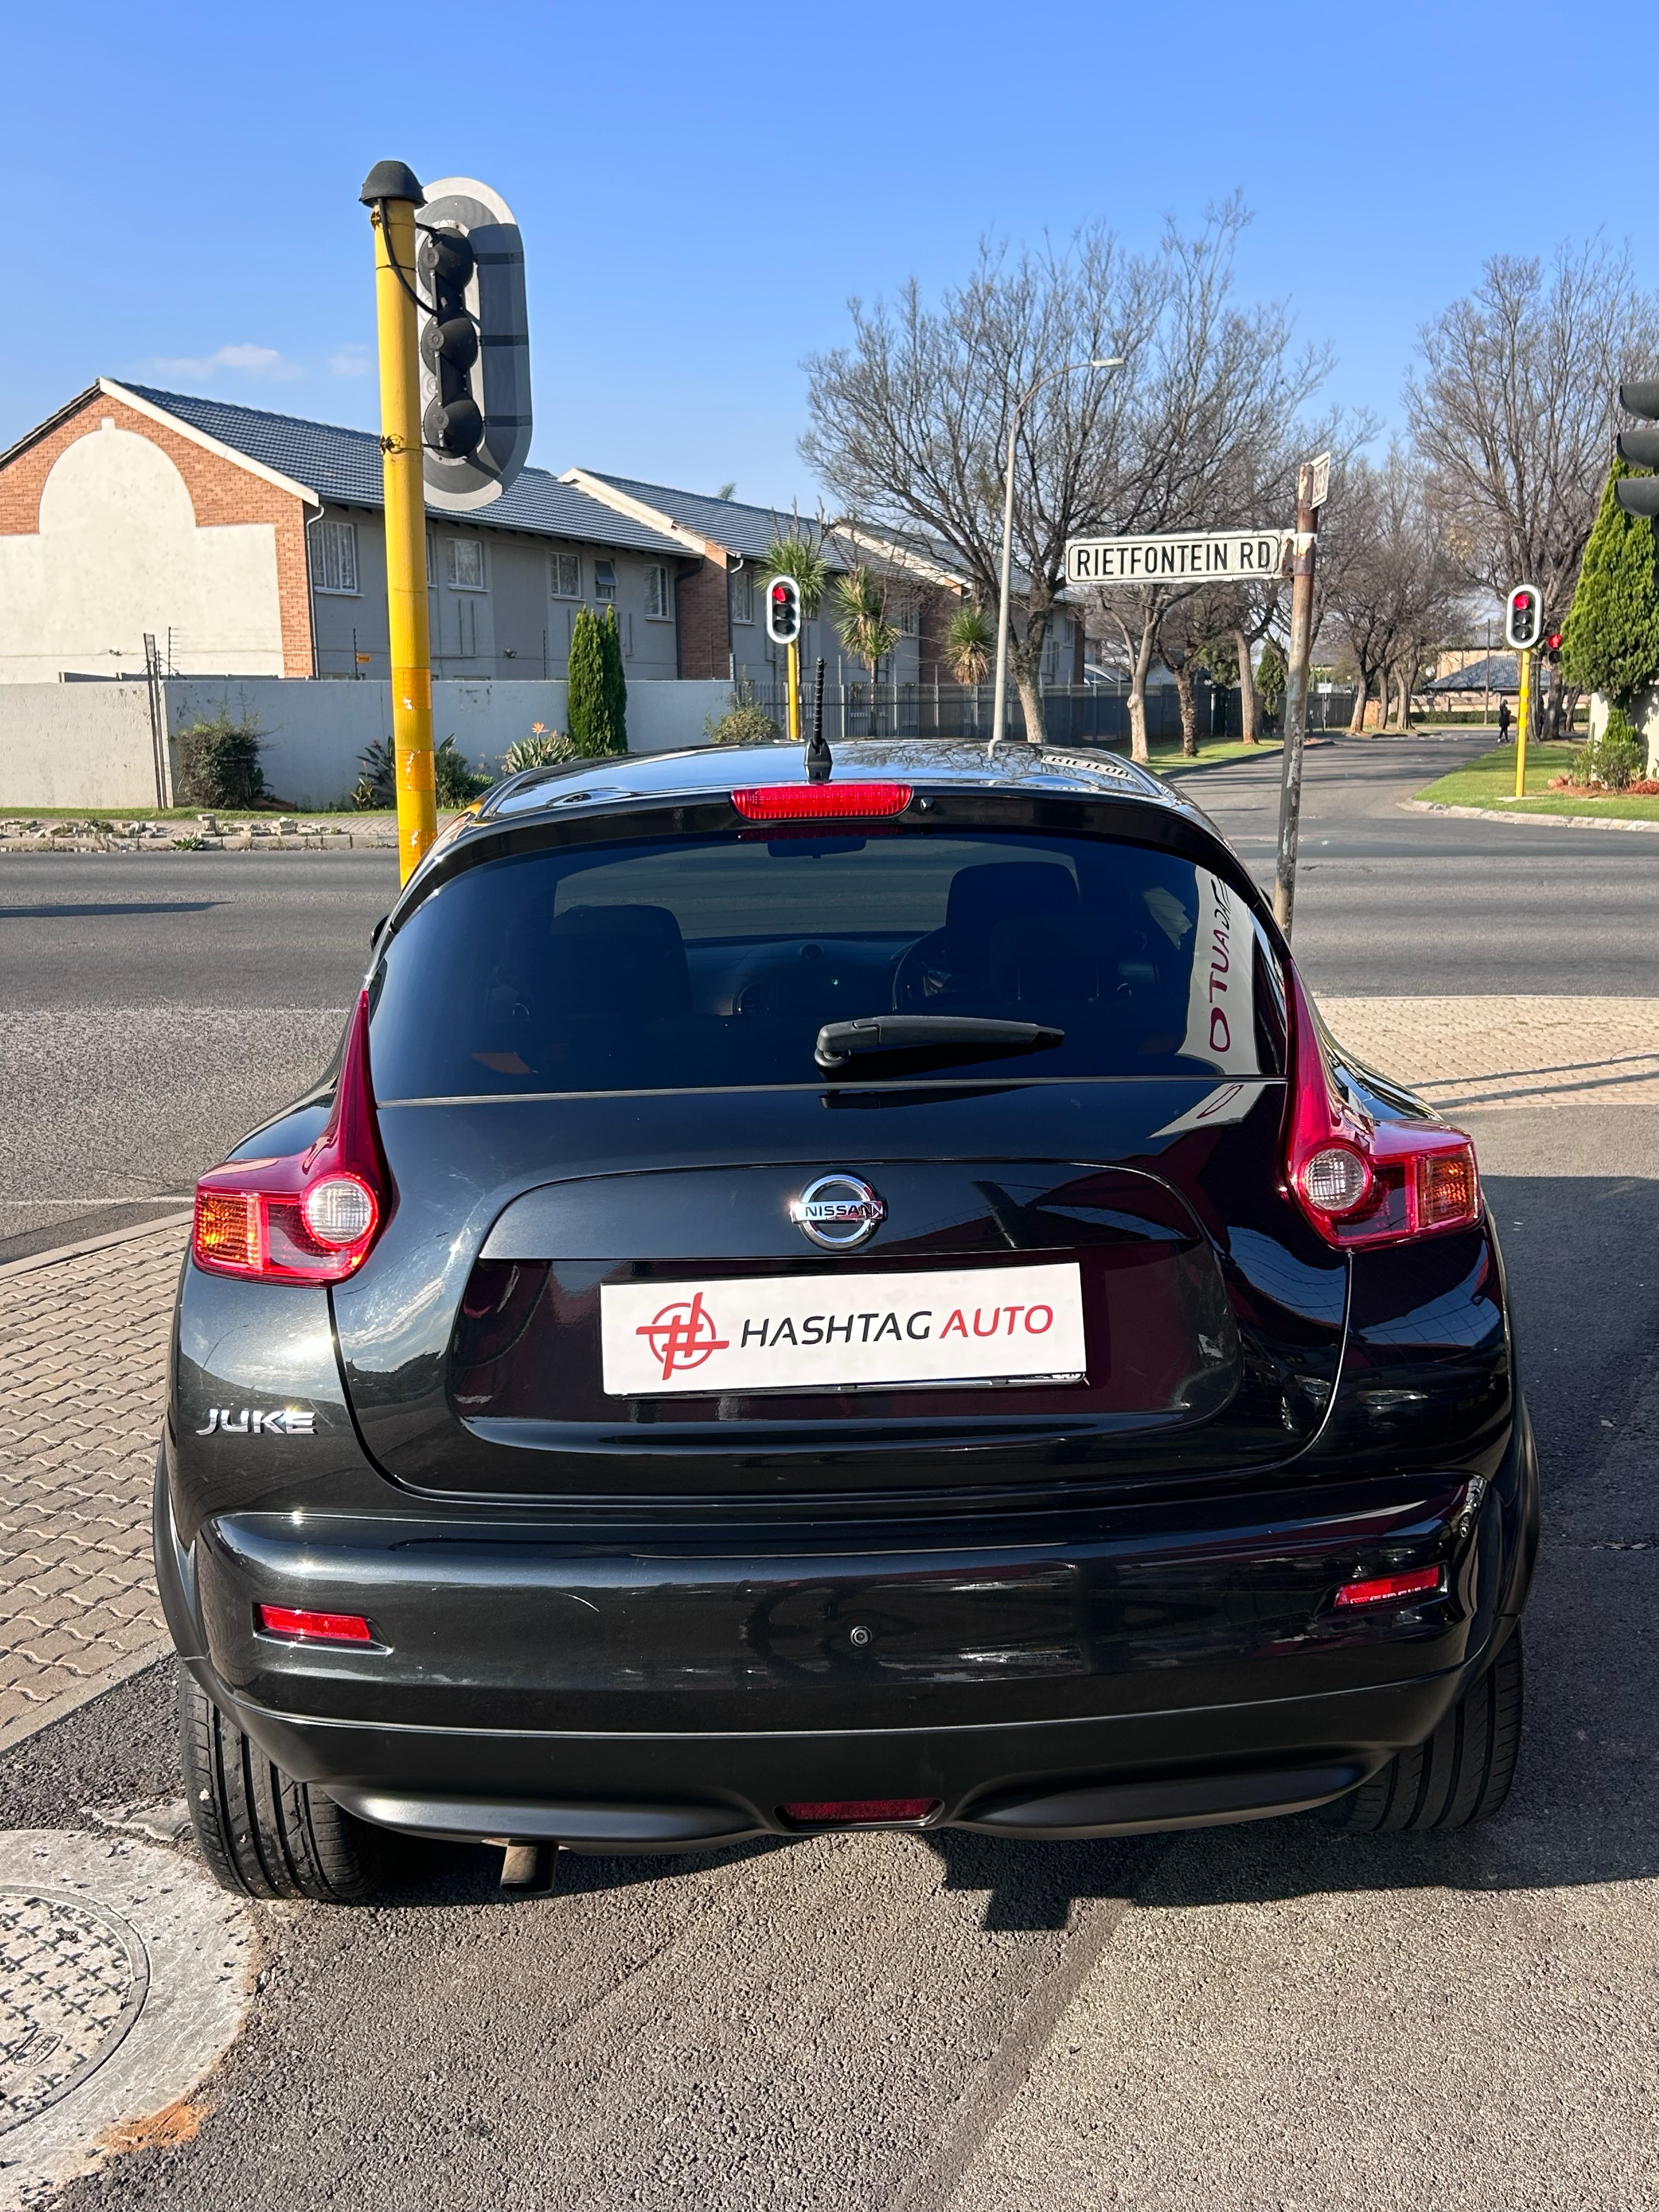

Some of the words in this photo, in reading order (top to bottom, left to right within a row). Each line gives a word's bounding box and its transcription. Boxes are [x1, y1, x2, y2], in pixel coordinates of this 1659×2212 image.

[1076, 543, 1228, 577] RIETFONTEIN
[1240, 541, 1270, 569] RD
[805, 1203, 882, 1217] NISSAN
[741, 1311, 932, 1348] HASHTAG
[940, 1304, 1054, 1339] AUTO
[195, 1408, 318, 1436] JUKE
